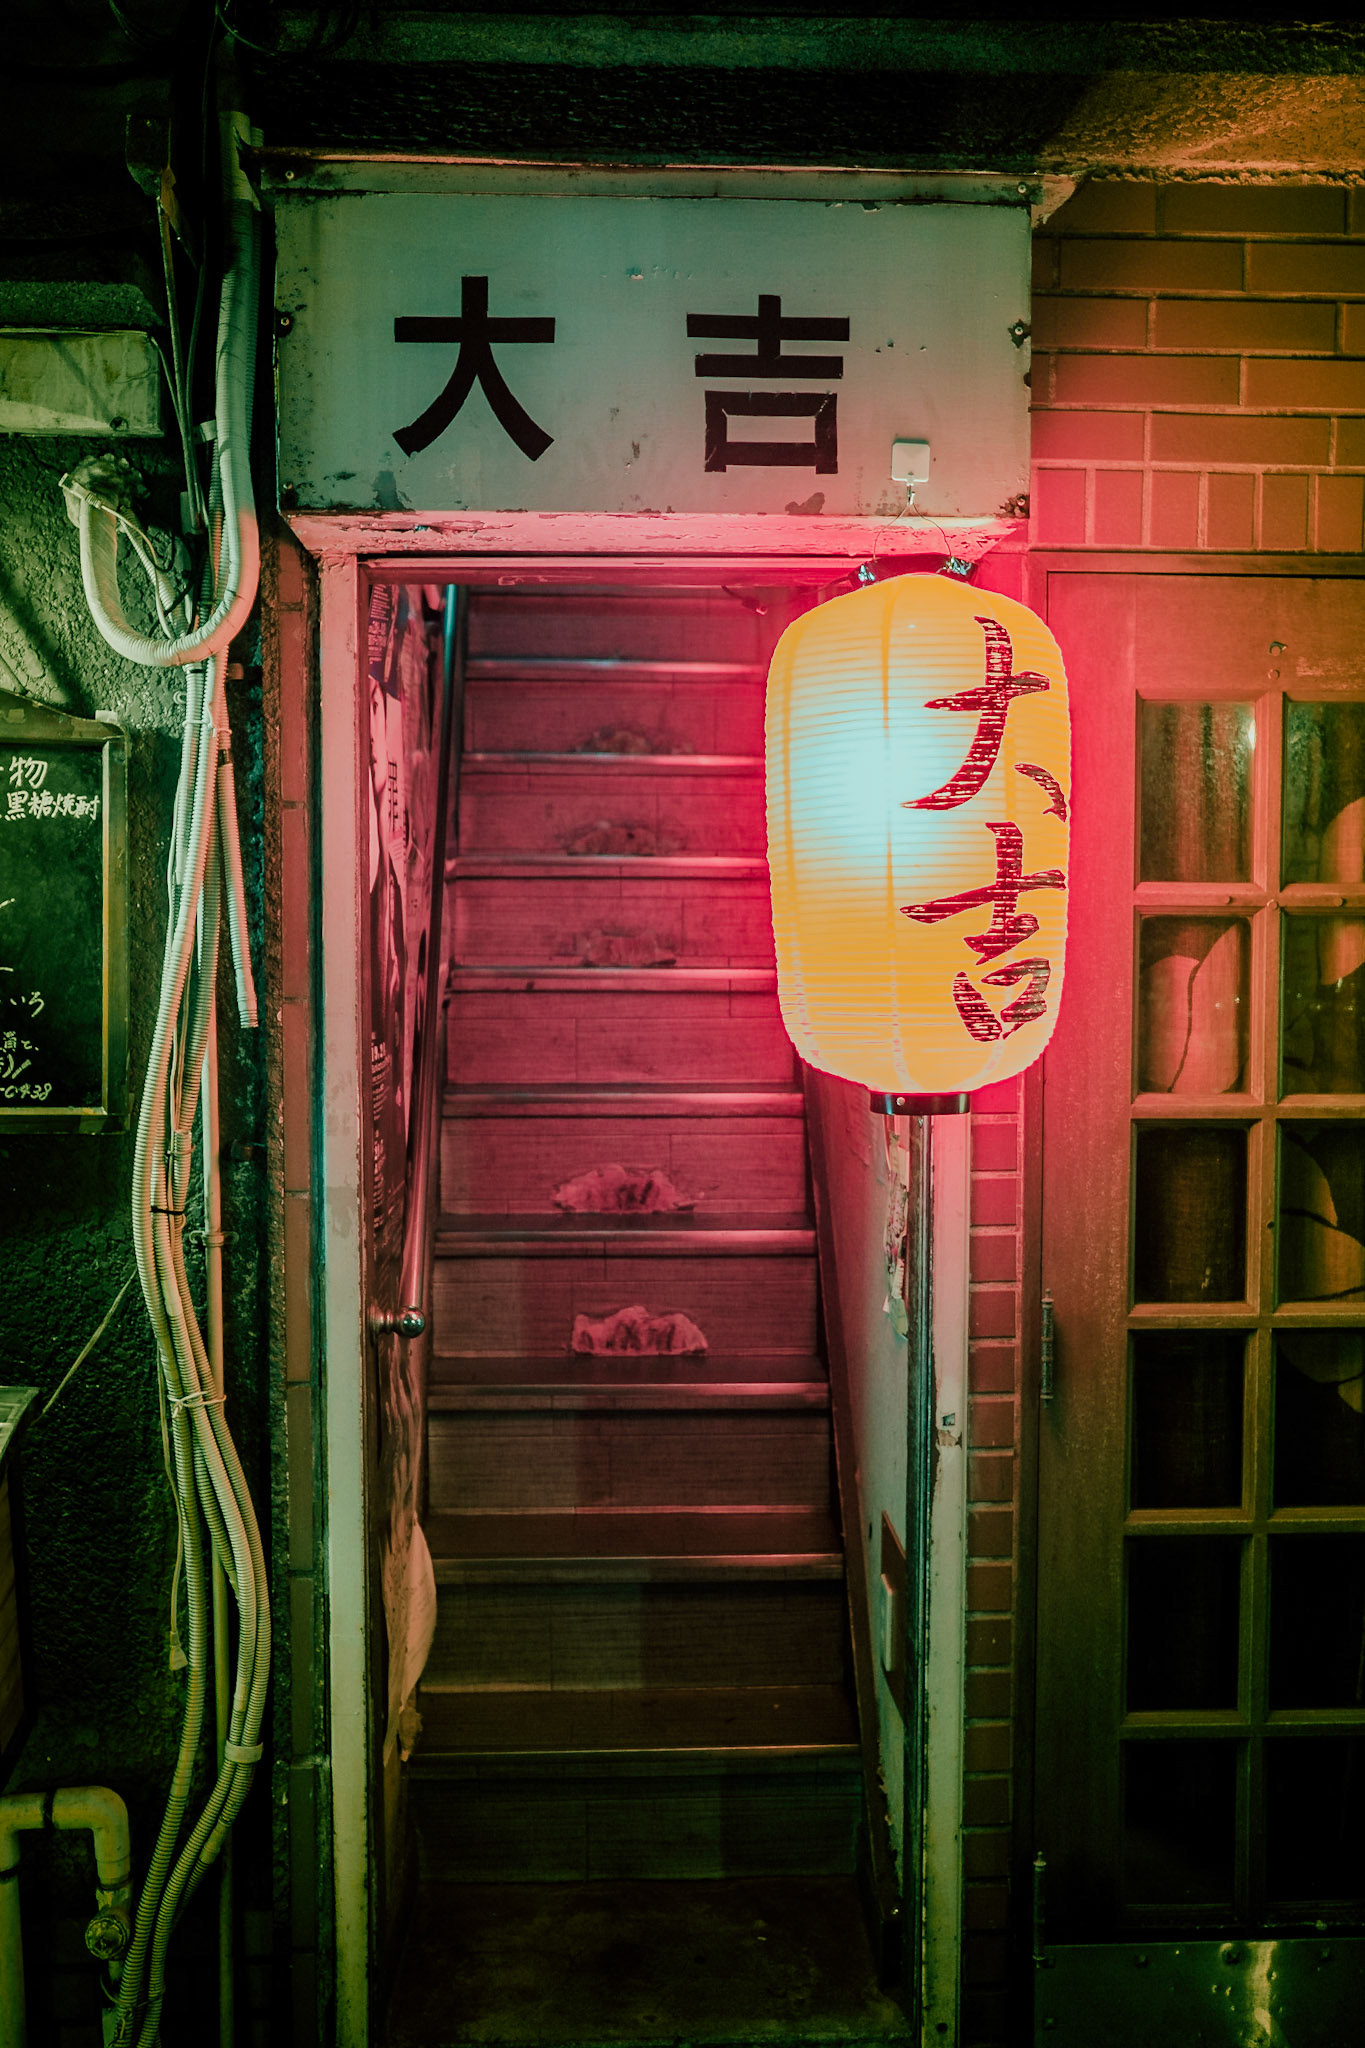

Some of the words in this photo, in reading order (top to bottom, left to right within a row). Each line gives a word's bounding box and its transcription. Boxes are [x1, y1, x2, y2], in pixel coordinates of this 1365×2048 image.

[392, 276, 850, 474] 大吉
[5, 789, 100, 821] 黒糖焼酎
[9, 756, 48, 789] 物
[901, 616, 1067, 1042] 大吉
